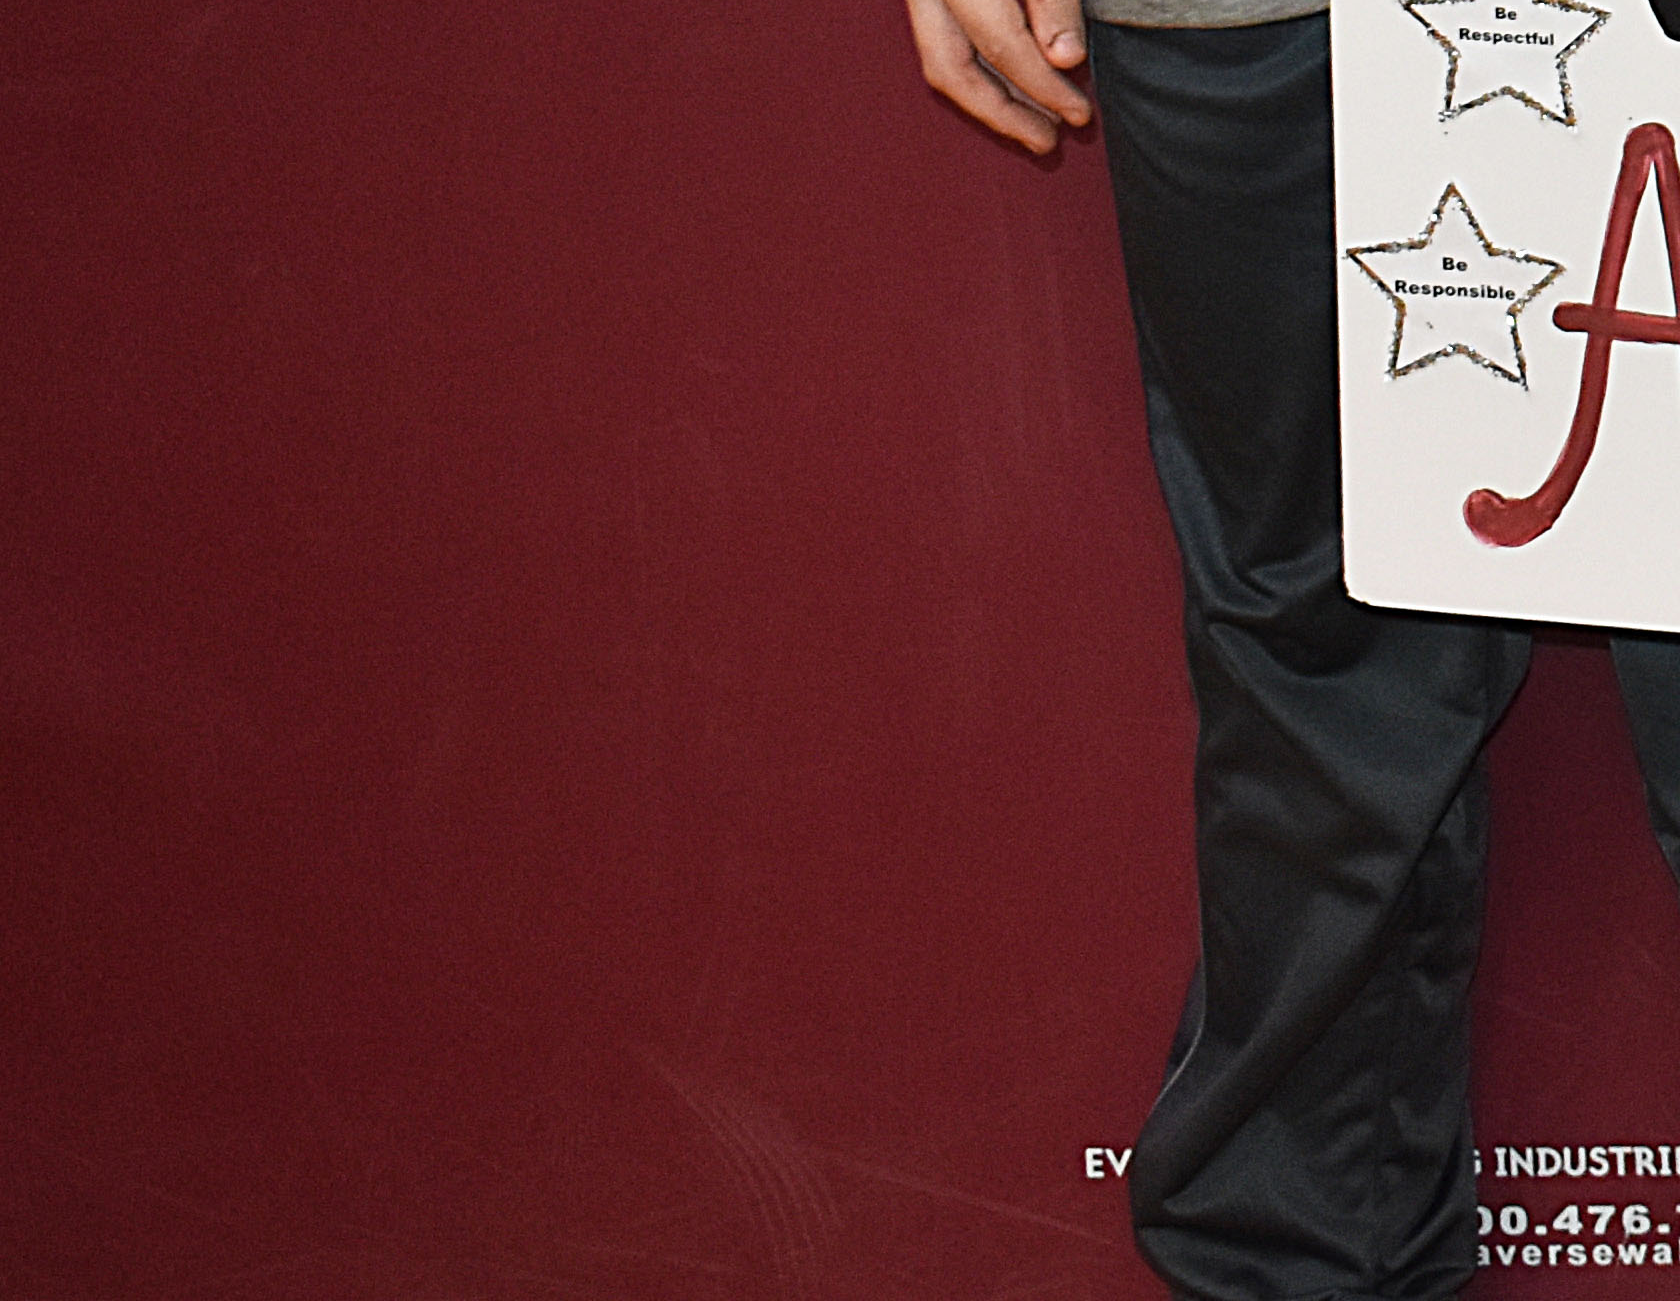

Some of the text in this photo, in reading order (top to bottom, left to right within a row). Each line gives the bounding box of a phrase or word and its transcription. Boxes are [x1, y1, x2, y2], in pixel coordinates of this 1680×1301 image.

[1495, 7, 1517, 20] Be
[1459, 28, 1554, 46] Respectful
[1442, 257, 1468, 272] Be
[1395, 279, 1516, 300] Responsible
